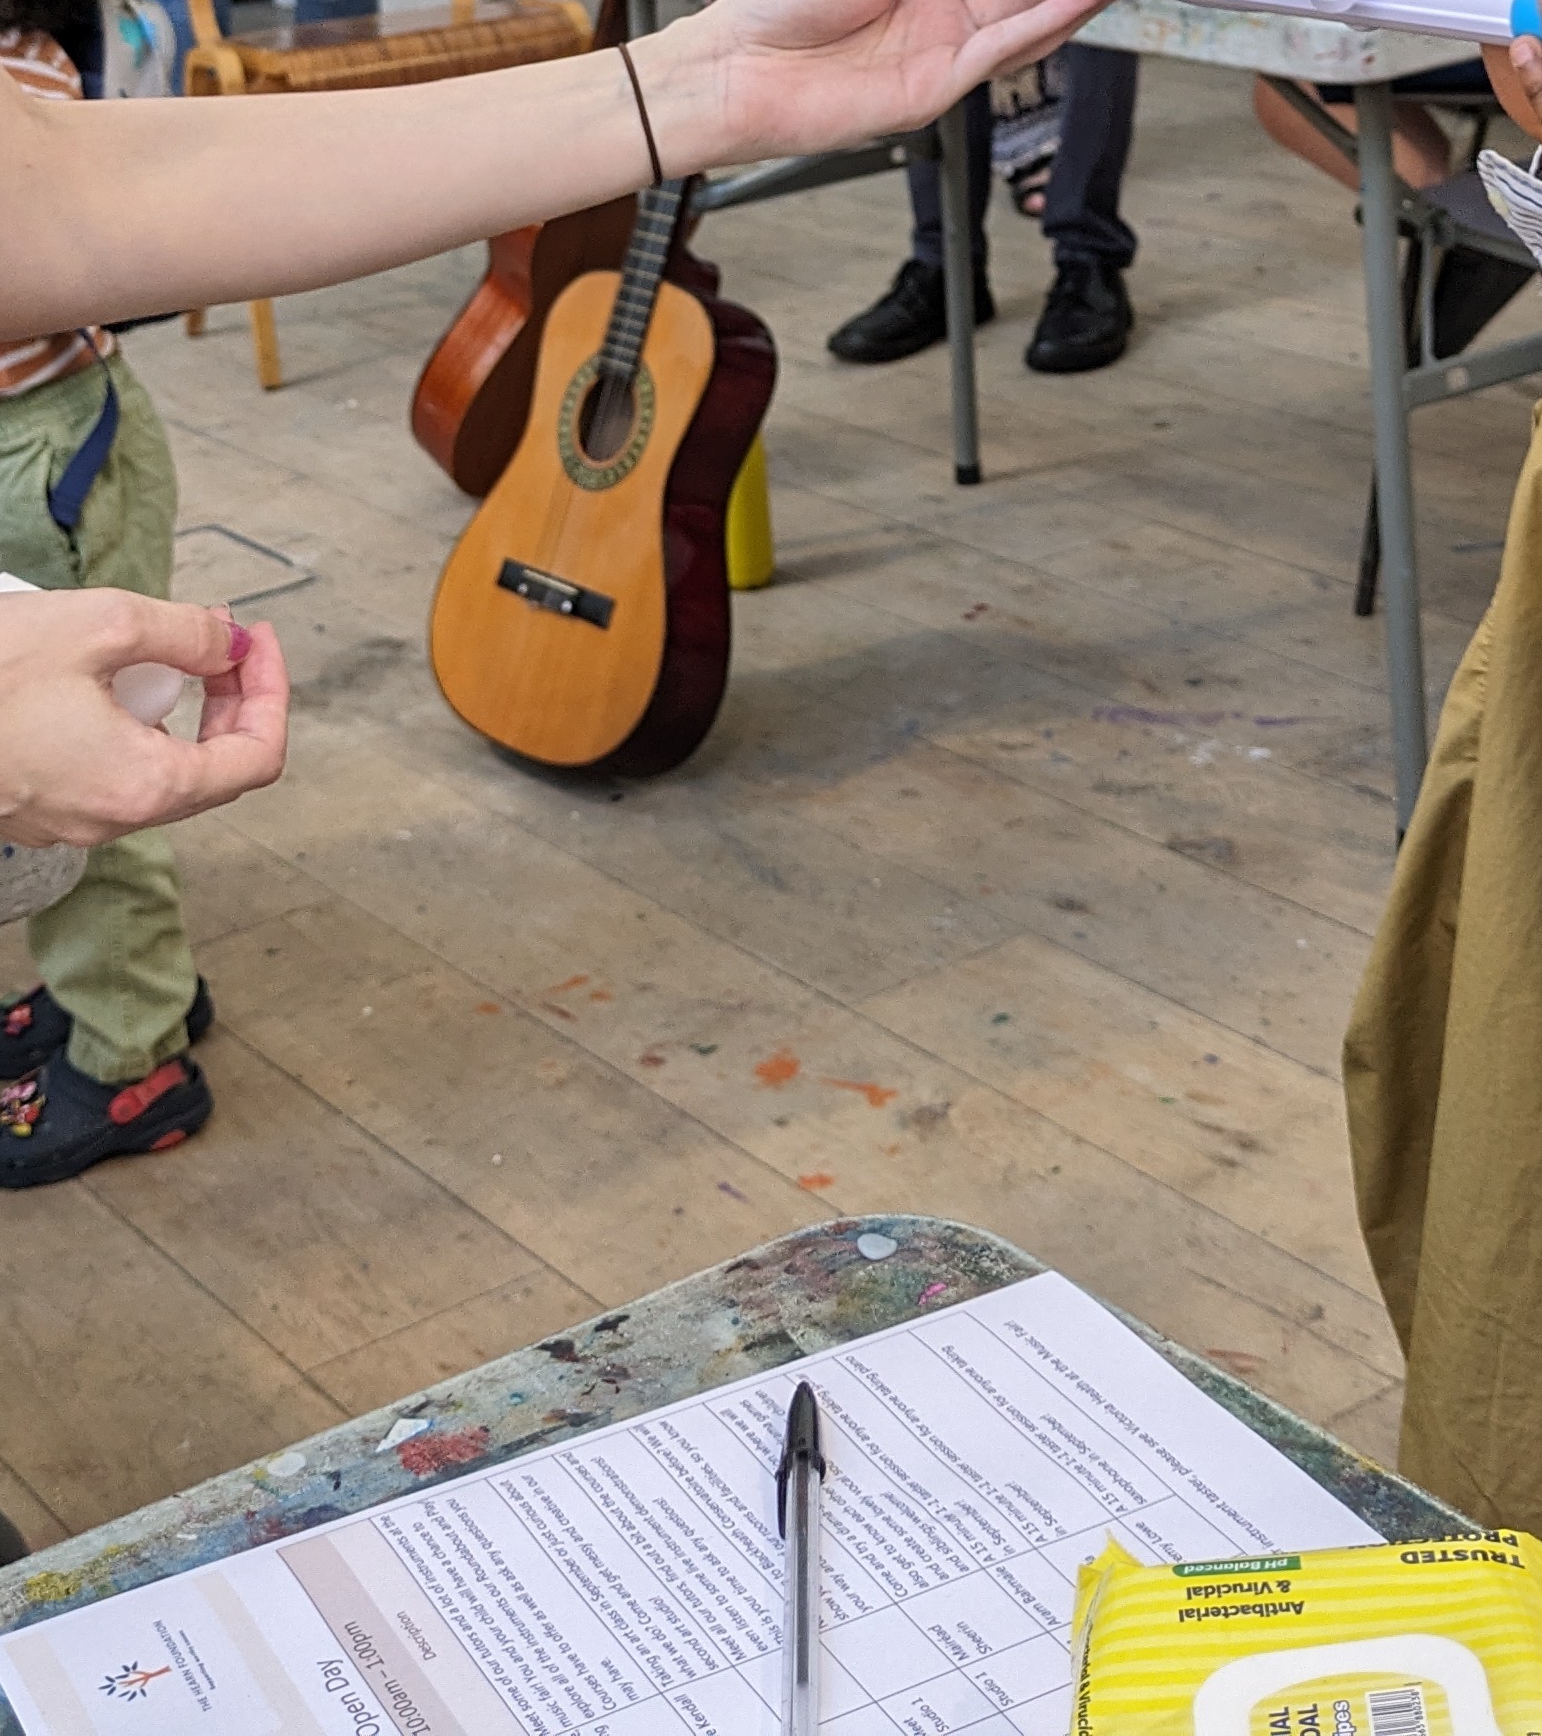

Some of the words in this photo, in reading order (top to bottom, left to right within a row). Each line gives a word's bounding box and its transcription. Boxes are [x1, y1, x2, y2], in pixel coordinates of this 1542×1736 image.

[1001, 1318, 1029, 1339] Fair!
[1023, 1334, 1054, 1361] Music
[1049, 1356, 1070, 1374] the
[1063, 1369, 1080, 1381] at
[1074, 1378, 1107, 1406] Heath
[630, 1421, 651, 1437] will
[1102, 1401, 1141, 1436] Victoria
[646, 1433, 664, 1451] We
[1137, 1431, 1160, 1449] see
[557, 1450, 580, 1466] and
[650, 1446, 690, 1478] before?
[1154, 1445, 1194, 1477] please
[519, 1473, 539, 1488] our
[573, 1463, 604, 1494] courses
[588, 1454, 650, 1517] demonstrations!
[1186, 1473, 1220, 1504] taster,
[497, 1478, 525, 1502] about
[531, 1485, 546, 1498] in
[597, 1491, 616, 1509] the
[414, 1497, 440, 1518] Play!
[444, 1496, 467, 1514] you
[517, 1499, 548, 1531] curious
[538, 1493, 571, 1527] creative
[878, 1490, 922, 1526] welcome!
[378, 1514, 396, 1530] the
[410, 1520, 426, 1533] to
[429, 1514, 452, 1532] and
[608, 1504, 637, 1532] about
[650, 1495, 696, 1538] questions!
[387, 1525, 403, 1537] at
[456, 1510, 494, 1551] questions
[539, 1528, 565, 1549] just
[560, 1524, 584, 1543] and
[628, 1528, 647, 1546] bit
[641, 1513, 687, 1560] instrument
[916, 1521, 954, 1556] siblings
[1134, 1520, 1167, 1547] Lowe
[418, 1529, 447, 1560] chance
[552, 1546, 569, 1558] or
[640, 1541, 653, 1551] a
[688, 1535, 709, 1553] any
[395, 1534, 438, 1586] instruments
[439, 1558, 452, 1567] a
[485, 1549, 506, 1567] any
[576, 1541, 605, 1569] messy
[644, 1547, 666, 1566] out
[680, 1556, 700, 1575] live
[701, 1549, 722, 1567] ask
[944, 1553, 970, 1573] and
[1263, 1558, 1288, 1573] pH
[1399, 1548, 1526, 1569] TRUSTED
[445, 1565, 468, 1590] have
[495, 1564, 517, 1582] ask
[597, 1565, 622, 1584] get
[655, 1563, 680, 1584] find
[715, 1564, 731, 1578] to
[760, 1567, 784, 1583] to
[1184, 1560, 1261, 1575] Balanced
[425, 1582, 445, 1595] of
[481, 1580, 502, 1598] our
[508, 1580, 525, 1593] as
[560, 1556, 606, 1603] September
[693, 1570, 721, 1596] some
[724, 1574, 748, 1596] time
[994, 1564, 1037, 1605] Bahmaie
[1186, 1580, 1274, 1600] Virucidal
[1275, 1579, 1291, 1593] &
[436, 1592, 455, 1610] lot
[456, 1586, 479, 1605] will
[607, 1581, 632, 1600] and
[674, 1579, 704, 1609] tutors,
[713, 1593, 729, 1607] to
[447, 1605, 460, 1615] a
[514, 1591, 538, 1612] well
[598, 1598, 613, 1613] in
[625, 1597, 652, 1626] Come
[646, 1594, 682, 1625] studio!
[741, 1594, 769, 1617] your
[1178, 1599, 1304, 1623] Antibacterial
[449, 1613, 473, 1633] and
[468, 1602, 495, 1626] child
[531, 1608, 548, 1622] as
[605, 1608, 630, 1631] class
[696, 1606, 717, 1624] our
[723, 1603, 750, 1632] listen
[759, 1614, 774, 1627] is
[1031, 1601, 1062, 1626] Aram
[395, 1609, 438, 1661] Description
[487, 1624, 515, 1647] your
[539, 1620, 564, 1643] offer
[620, 1628, 641, 1644] art
[642, 1623, 667, 1642] do?
[672, 1622, 693, 1638] art
[707, 1622, 728, 1636] all
[955, 1619, 994, 1655] Sheerin
[342, 1619, 385, 1670] 1:00pm
[465, 1630, 493, 1660] tutors
[557, 1641, 572, 1655] to
[633, 1641, 651, 1657] an
[660, 1639, 679, 1657] we
[718, 1633, 748, 1662] Meet
[743, 1628, 769, 1652] even
[925, 1623, 971, 1664] Mairéad
[499, 1644, 525, 1664] and
[532, 1645, 552, 1664] the
[565, 1651, 590, 1677] have
[681, 1636, 720, 1671] second
[315, 1658, 351, 1693] Day
[484, 1658, 505, 1676] our
[516, 1662, 538, 1684] You
[539, 1662, 560, 1674] of
[599, 1655, 624, 1684] have.
[644, 1653, 675, 1688] Taking
[670, 1653, 698, 1679] what
[973, 1670, 988, 1680] 1
[180, 1667, 204, 1697] HEARN
[492, 1674, 513, 1686] of
[549, 1672, 570, 1686] all
[505, 1684, 533, 1712] some
[527, 1680, 553, 1702] fair!
[562, 1683, 596, 1720] explore
[582, 1673, 618, 1711] Courses
[615, 1680, 640, 1702] may
[909, 1695, 924, 1706] 1
[982, 1677, 1015, 1707] Studio
[195, 1694, 213, 1713] THE
[385, 1679, 431, 1736] 10:00am
[544, 1698, 574, 1729] music
[672, 1692, 711, 1730] Kendall
[918, 1703, 950, 1733] Studio
[1332, 1700, 1358, 1736] ipes
